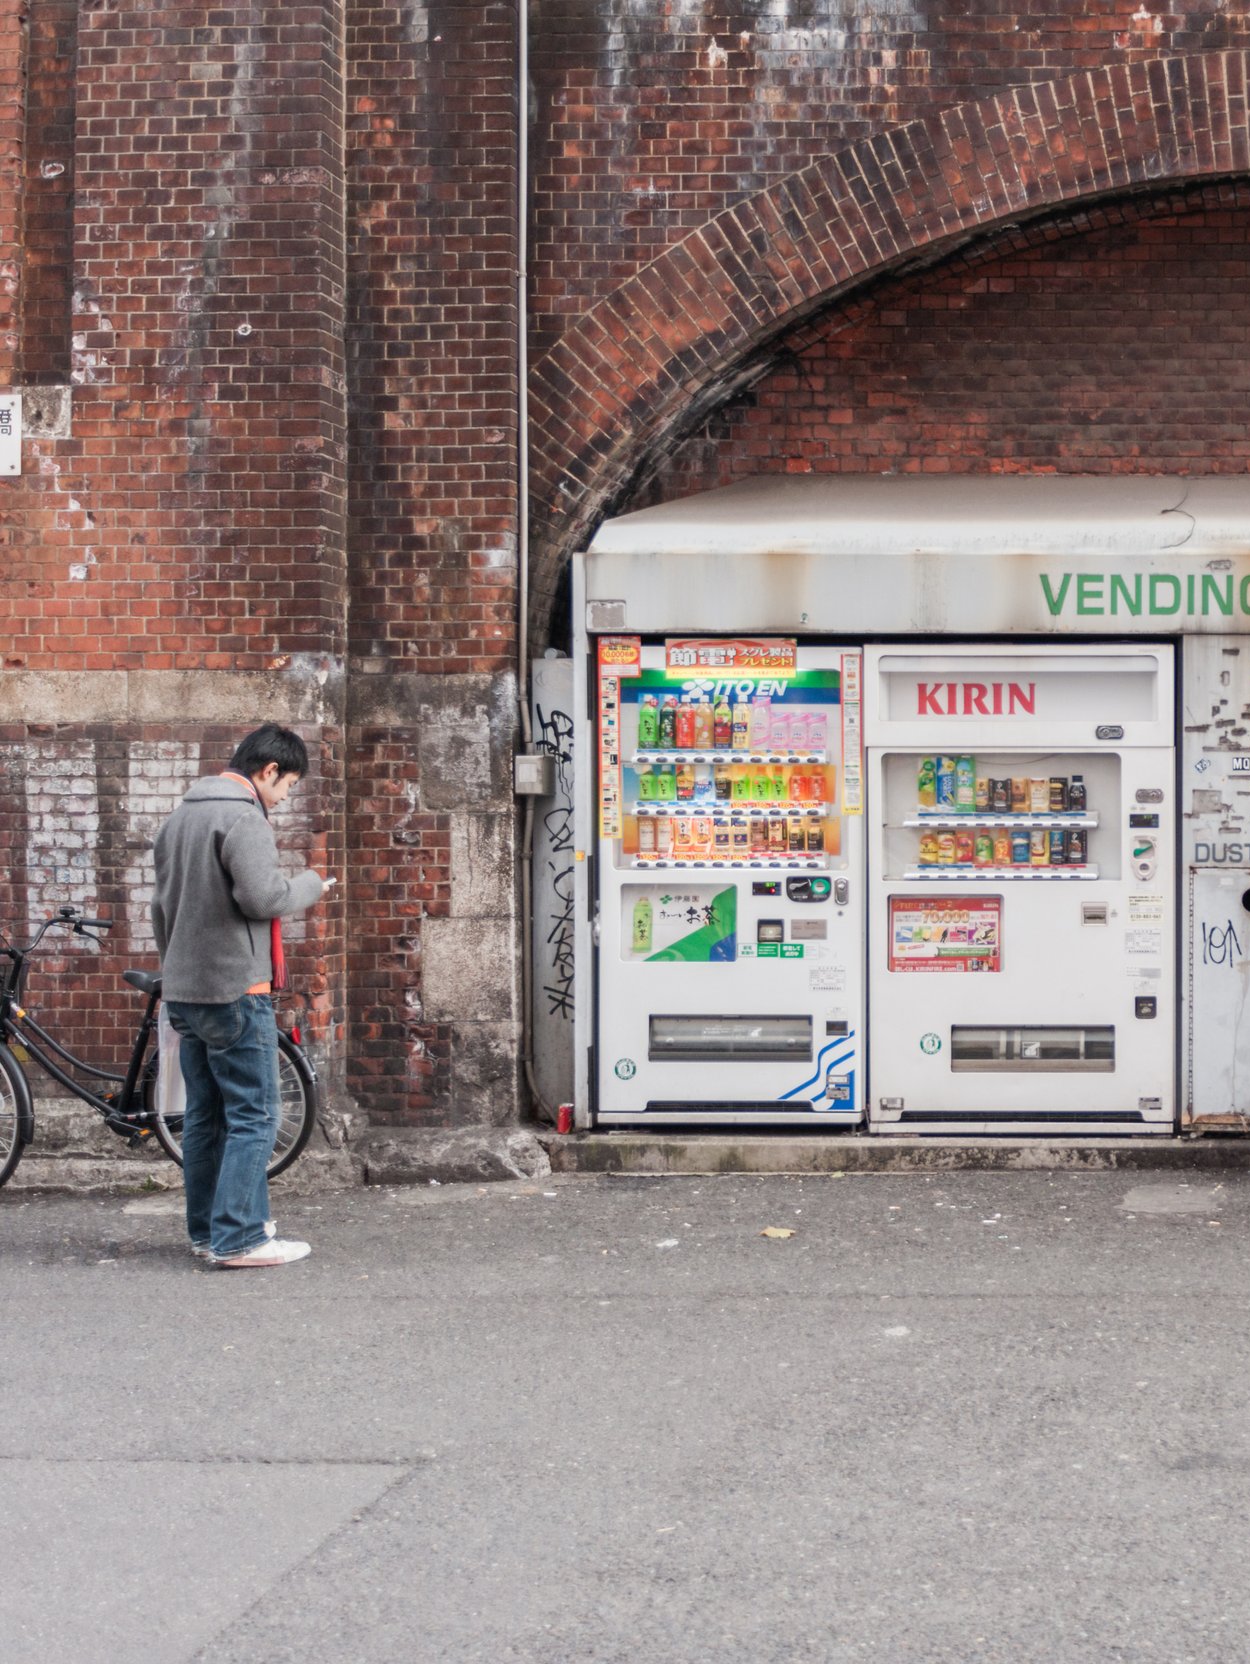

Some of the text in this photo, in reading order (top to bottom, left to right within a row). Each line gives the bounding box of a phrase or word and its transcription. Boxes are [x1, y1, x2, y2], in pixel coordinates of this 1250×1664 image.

[714, 680, 788, 697] ITO EN
[917, 682, 1036, 715] KIRIN
